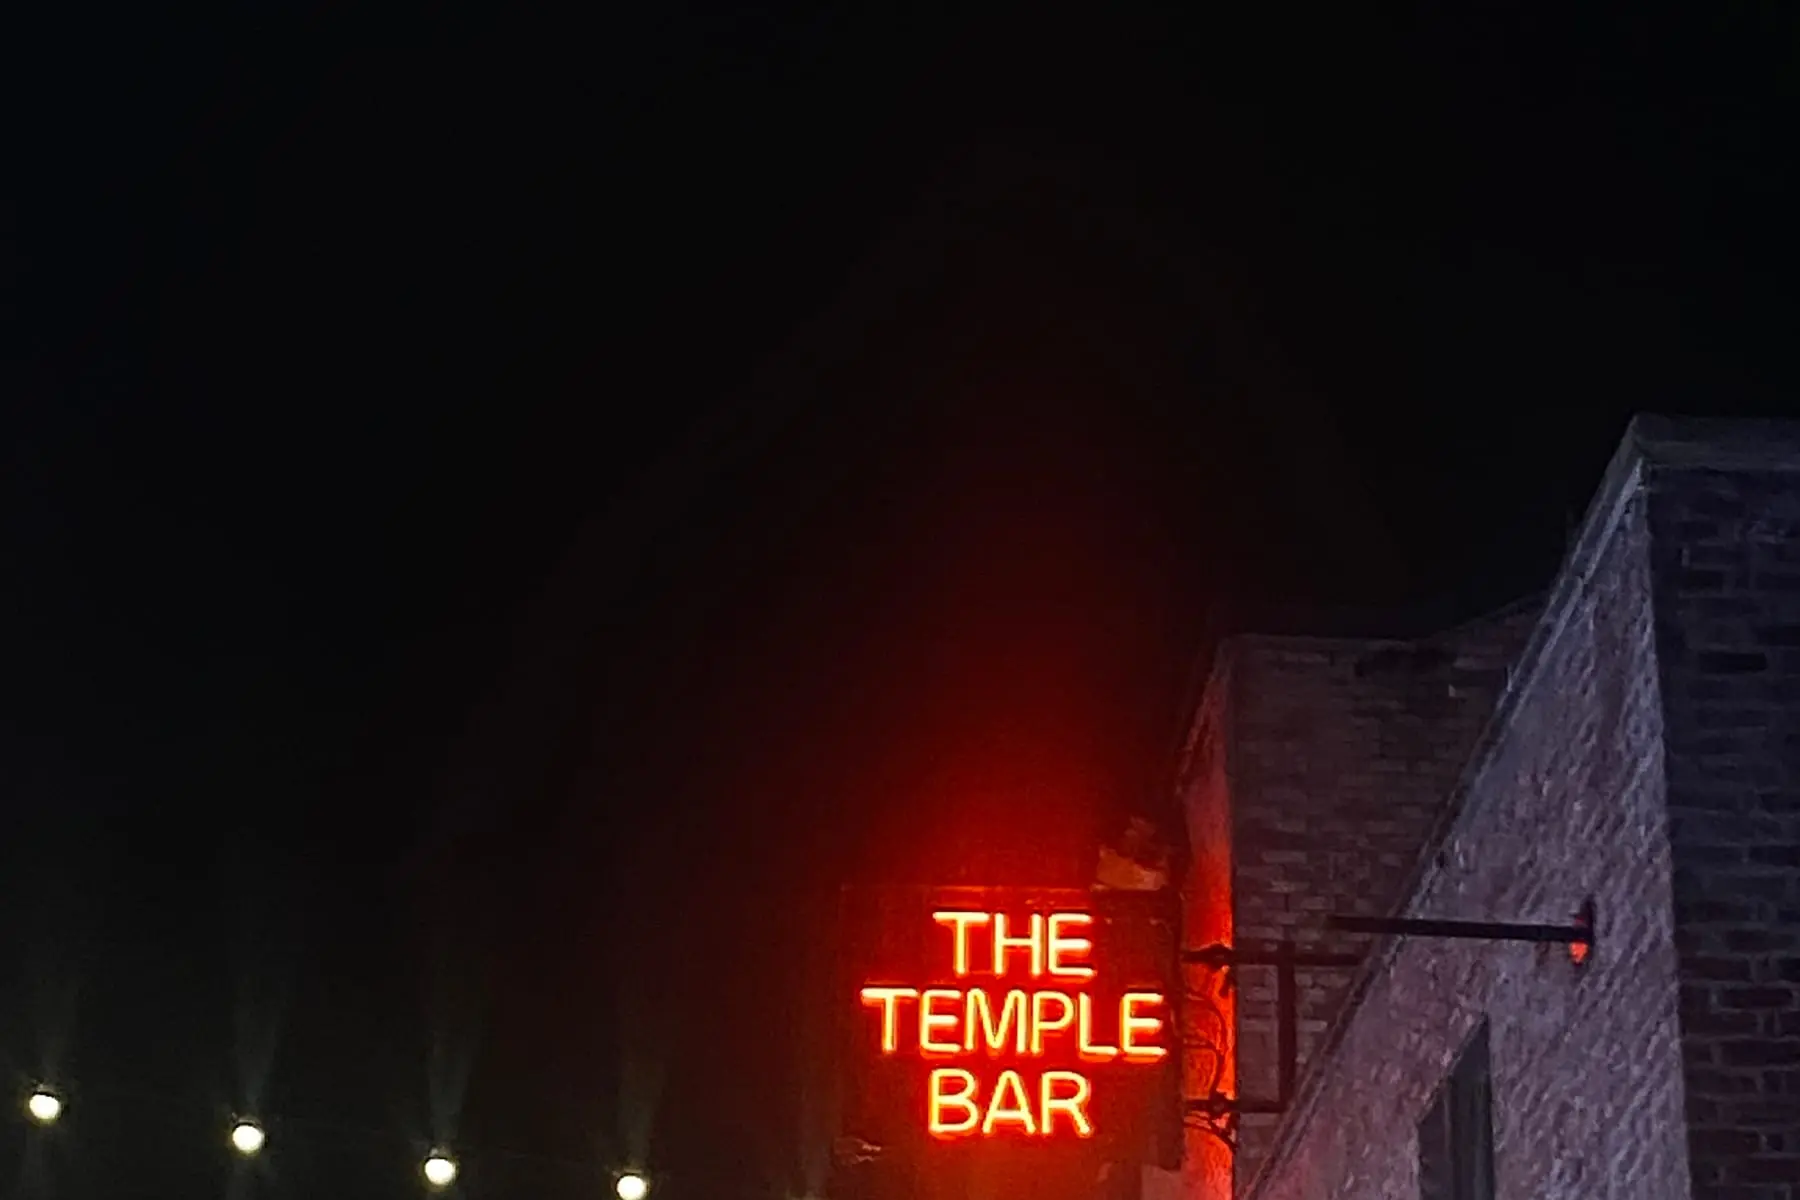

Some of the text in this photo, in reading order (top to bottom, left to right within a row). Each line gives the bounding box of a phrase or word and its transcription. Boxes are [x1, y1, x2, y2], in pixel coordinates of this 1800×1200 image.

[932, 911, 1096, 977] THE
[860, 987, 1168, 1058] TEMPLE
[928, 1067, 1094, 1137] BAR
